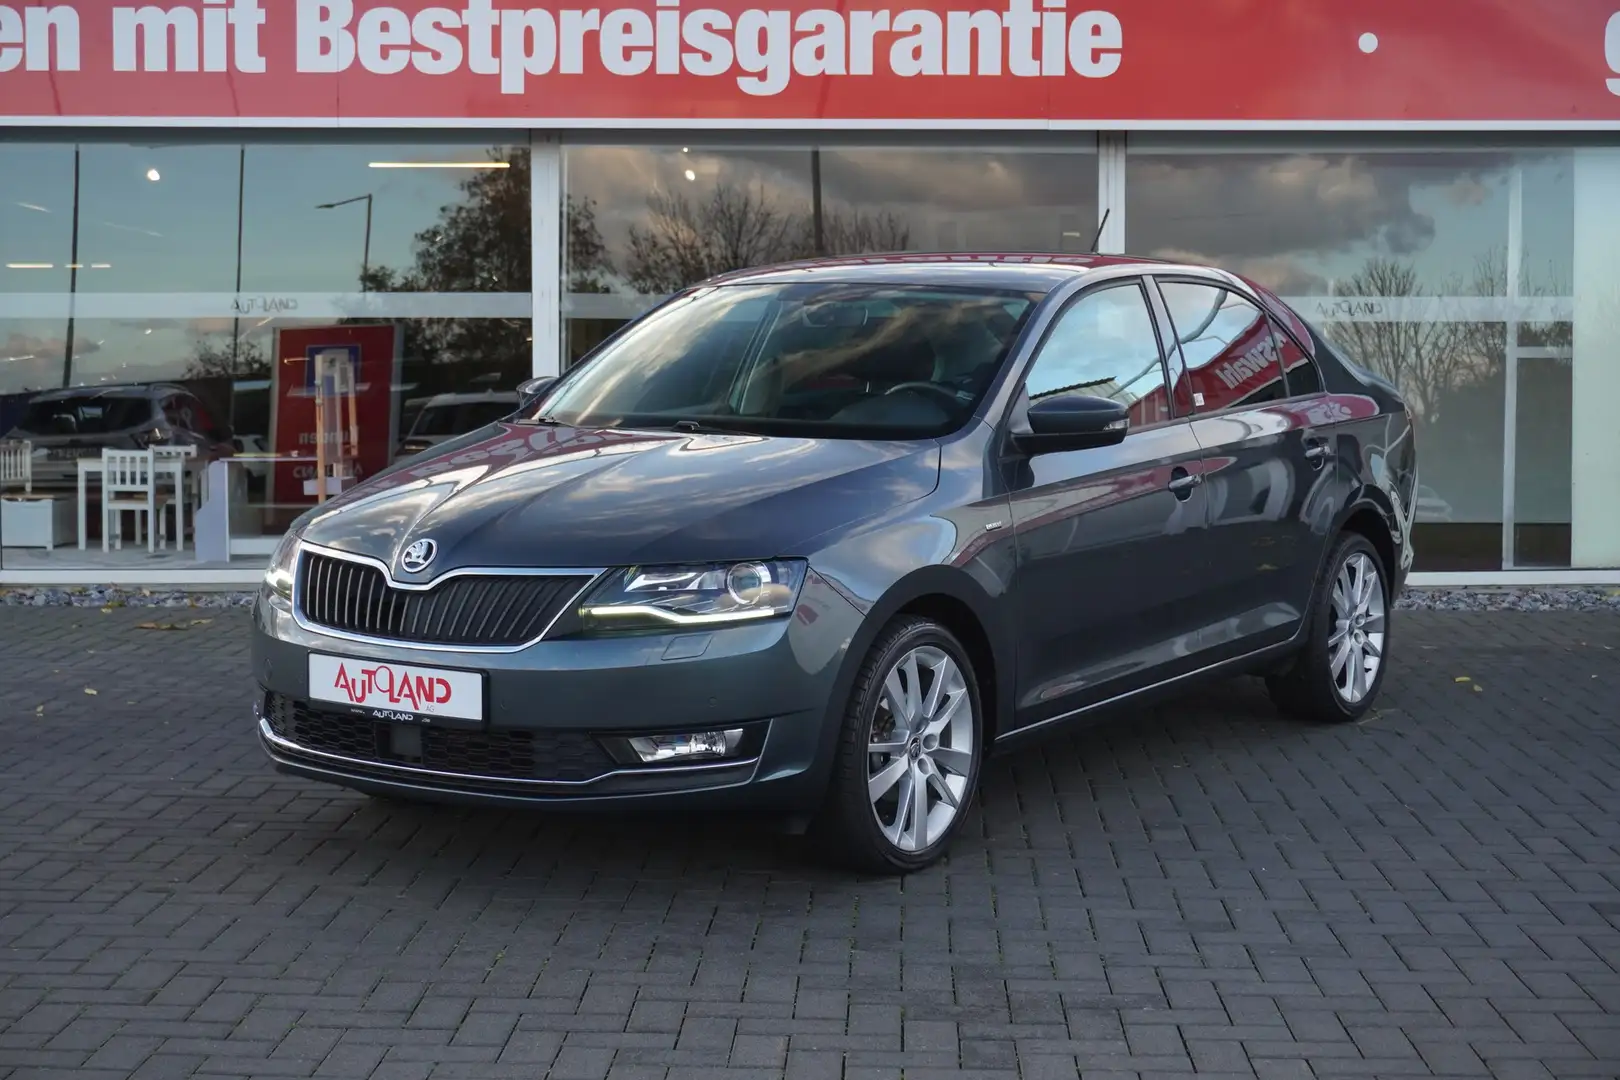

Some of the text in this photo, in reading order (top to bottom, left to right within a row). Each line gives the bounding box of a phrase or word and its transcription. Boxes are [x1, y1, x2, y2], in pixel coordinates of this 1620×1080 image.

[113, 0, 266, 74] mit
[297, 0, 1122, 96] Bestpreisgarantie
[334, 663, 451, 710] AUTOLAND
[372, 710, 413, 721] AUTOLAND
